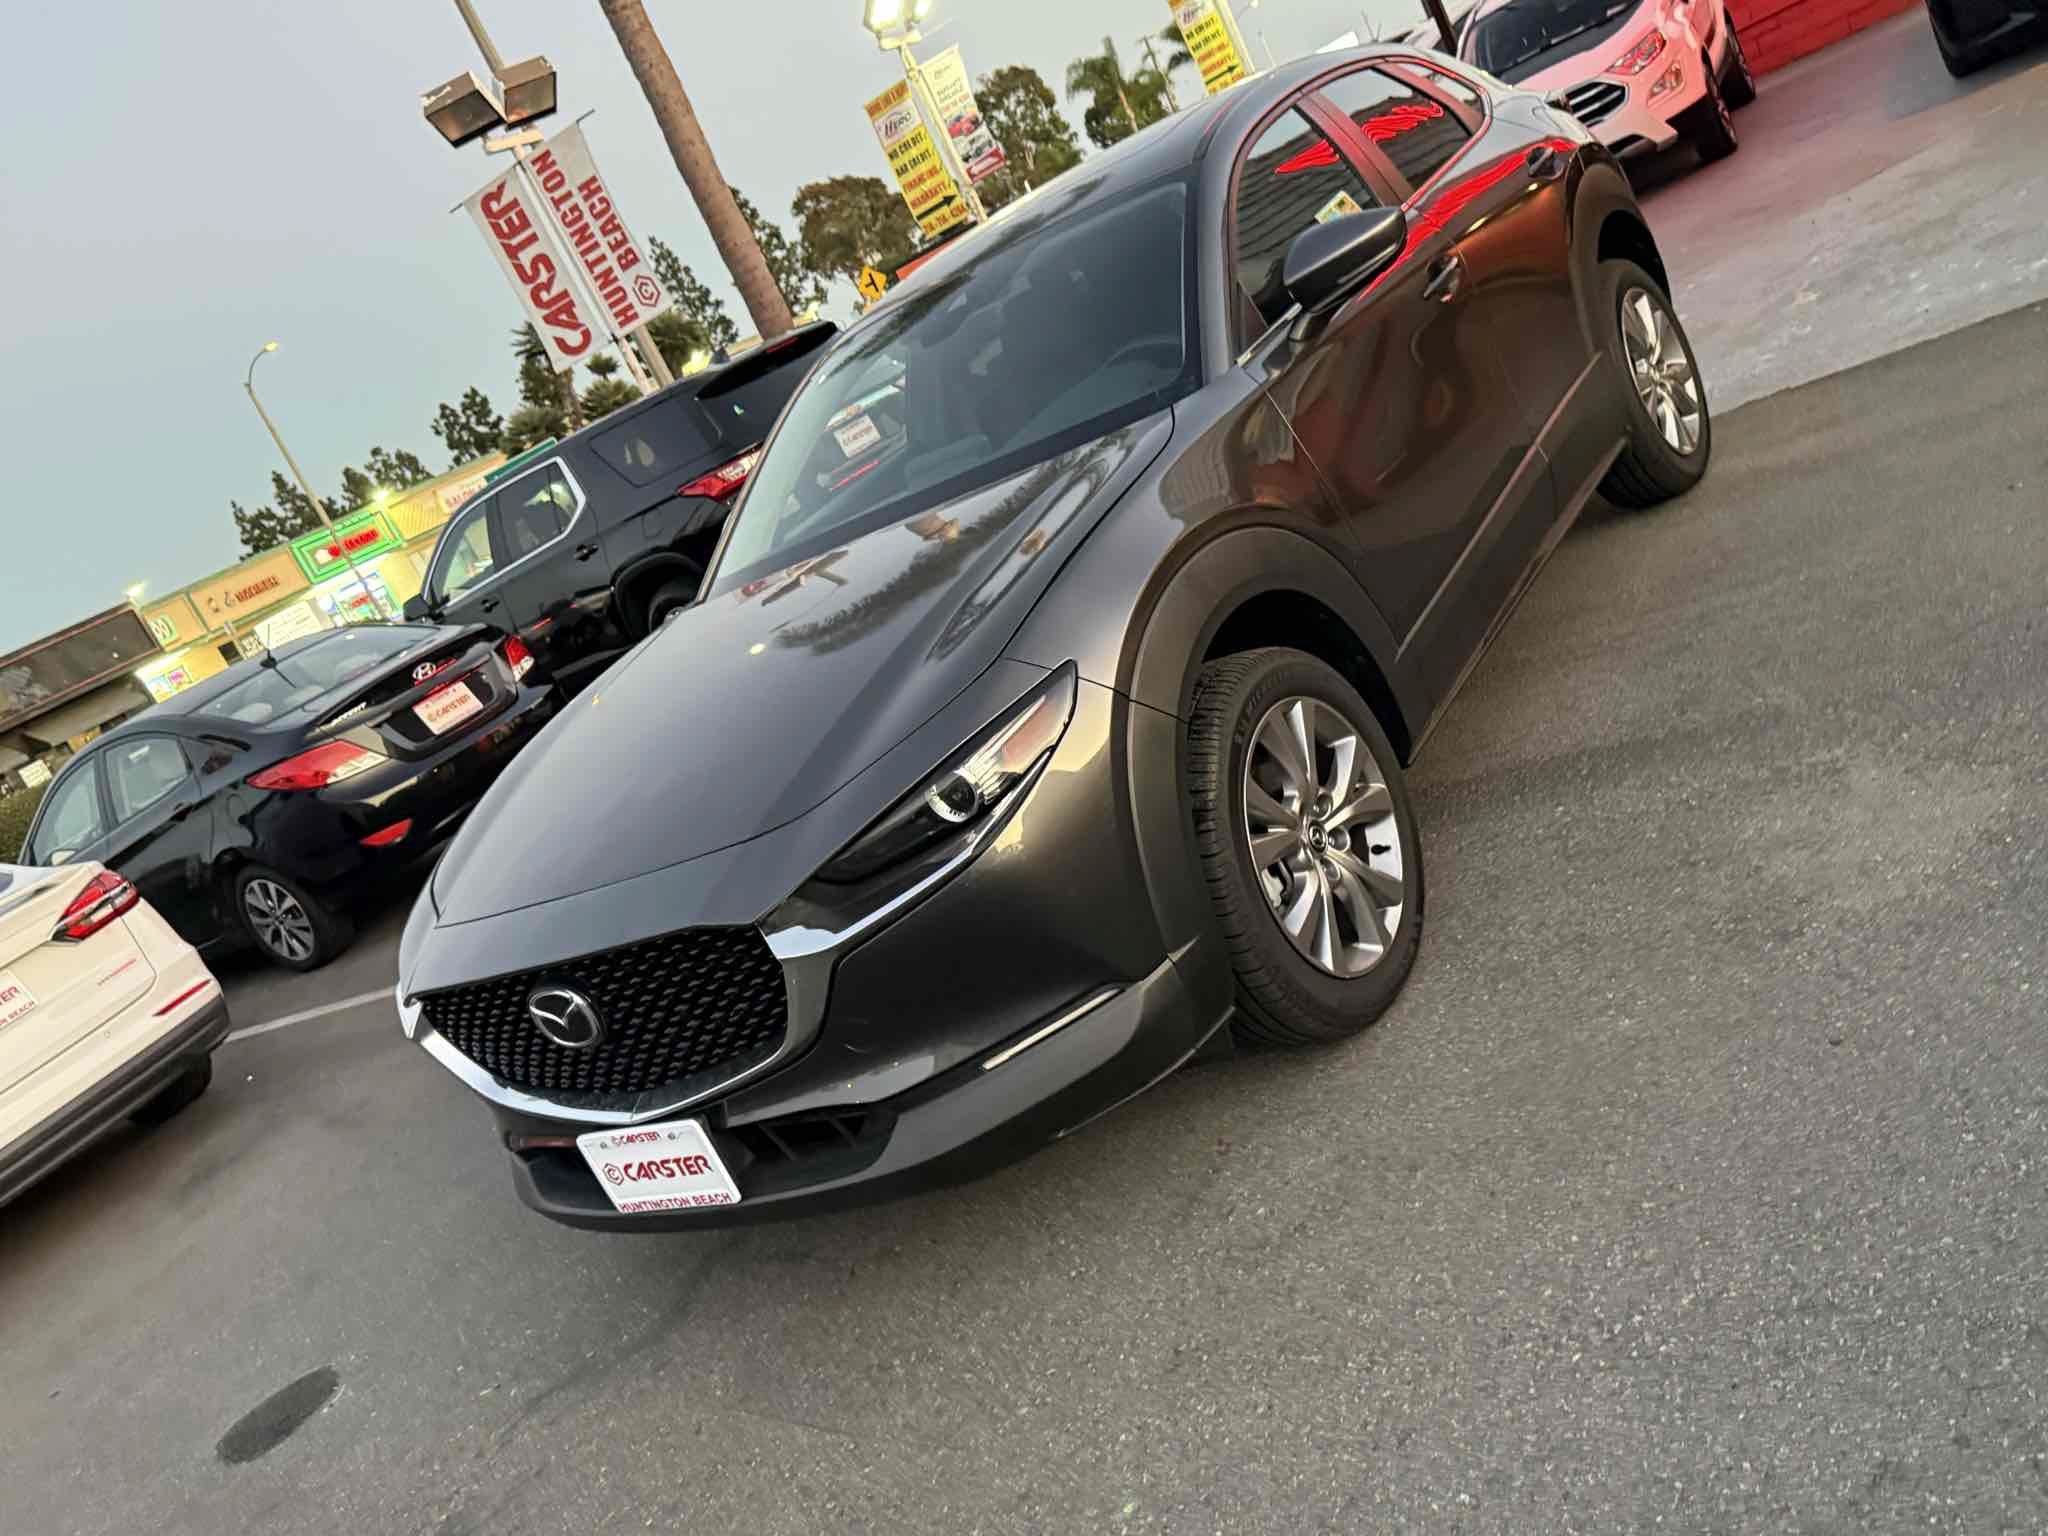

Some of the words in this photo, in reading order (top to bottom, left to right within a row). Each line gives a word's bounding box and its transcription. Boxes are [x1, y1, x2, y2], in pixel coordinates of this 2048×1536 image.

[530, 149, 640, 329] HUNTINGTON
[577, 175, 641, 273] BEACH
[480, 177, 592, 358] CARSTER
[620, 1131, 662, 1145] CARSTER
[623, 1154, 714, 1182] CARSTER
[618, 1197, 690, 1212] HUNTINGTON
[692, 1192, 732, 1207] BEACH
